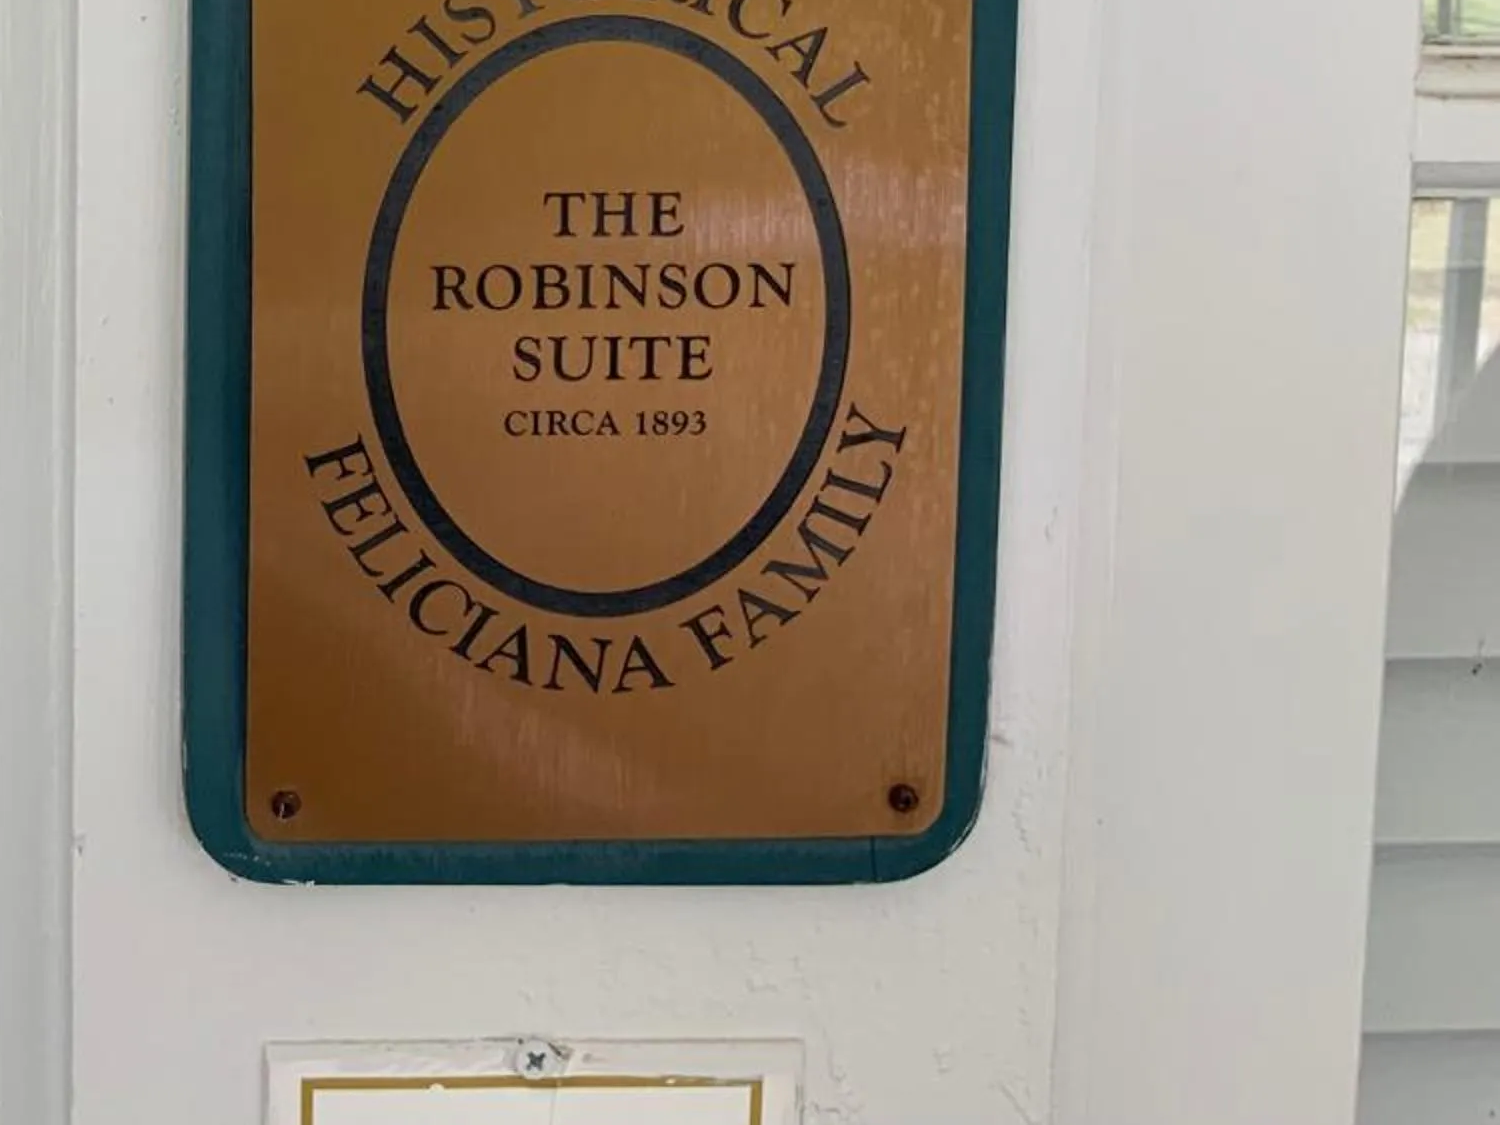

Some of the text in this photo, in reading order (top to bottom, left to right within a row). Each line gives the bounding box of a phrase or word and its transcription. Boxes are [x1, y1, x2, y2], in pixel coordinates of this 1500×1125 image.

[543, 191, 684, 237] THE
[432, 261, 796, 311] ROBINSON
[511, 335, 714, 383] SUITE
[503, 408, 708, 437] CIRCA 1893
[304, 402, 908, 693] FELICIANA FAMILY
